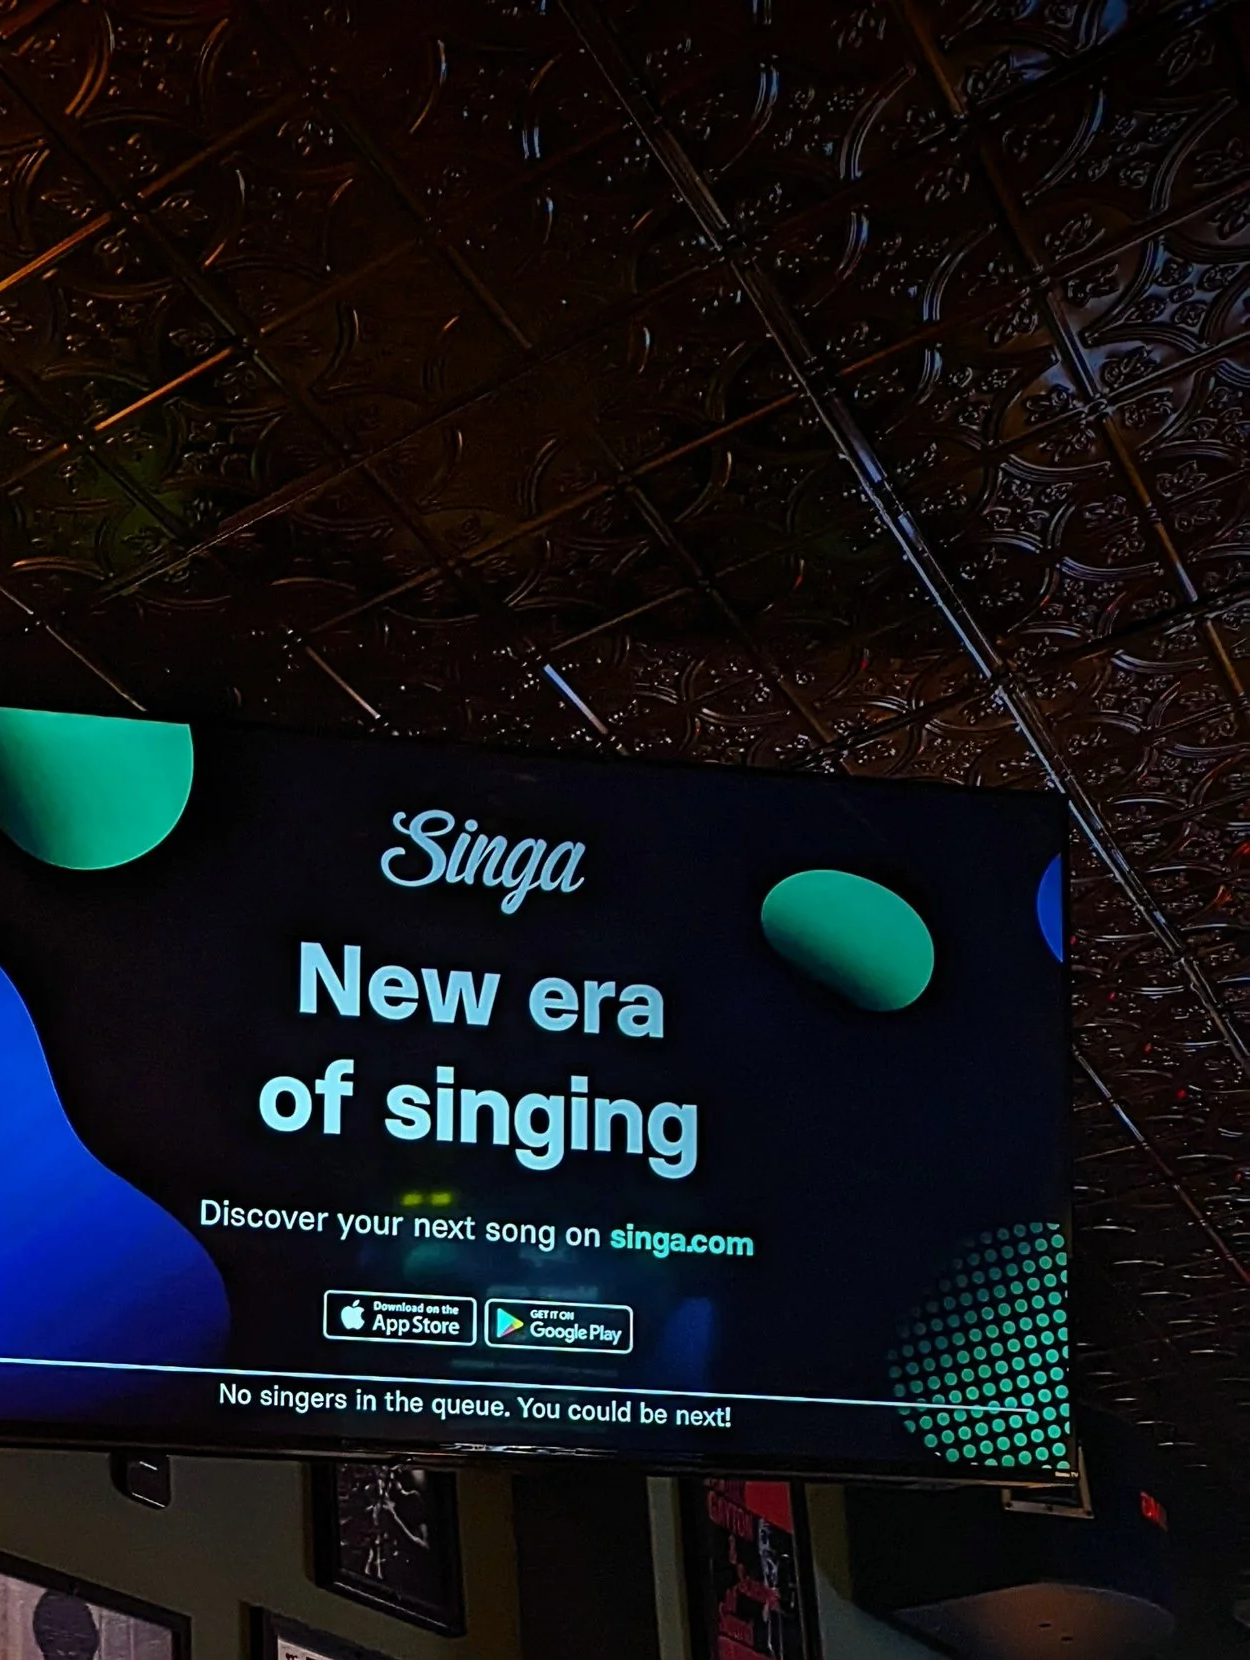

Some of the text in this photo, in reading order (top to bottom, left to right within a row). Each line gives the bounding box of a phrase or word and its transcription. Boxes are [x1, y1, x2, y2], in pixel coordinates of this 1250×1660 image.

[381, 810, 585, 914] Singa
[300, 942, 664, 1037] New era
[259, 1059, 697, 1178] of singing
[200, 1199, 753, 1258] Discover your next song on singa.com
[372, 1315, 460, 1335] App Store
[374, 1301, 459, 1315] Download on the
[530, 1310, 574, 1320] GET IT ON
[530, 1320, 622, 1346] Google Play
[219, 1383, 731, 1427] No singers in the queue. You could be next!
